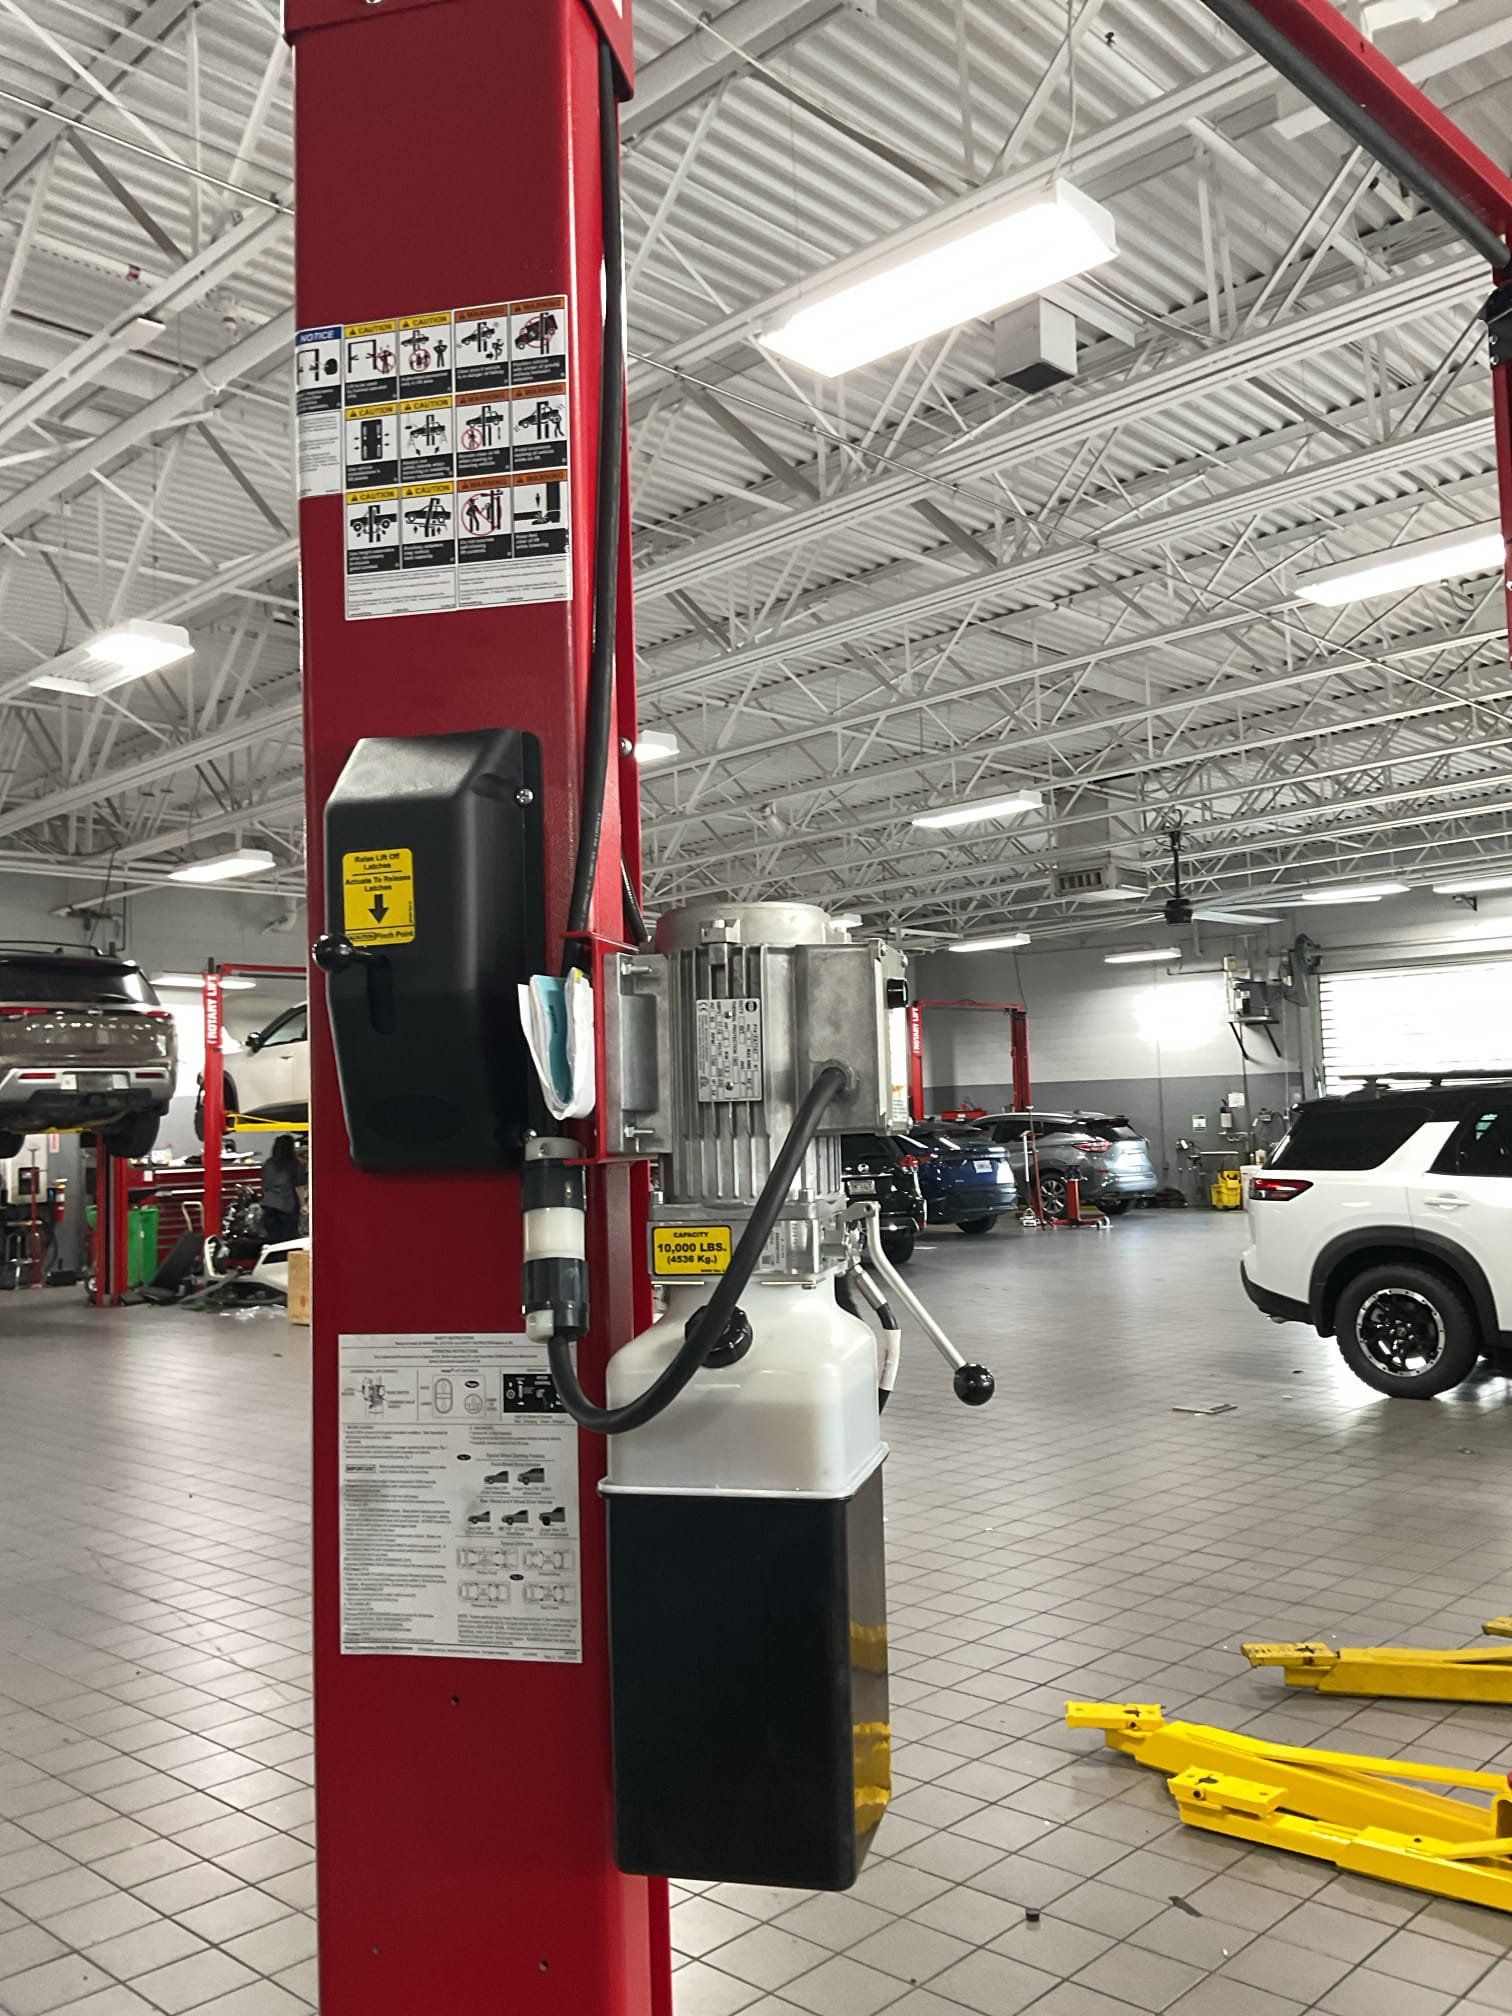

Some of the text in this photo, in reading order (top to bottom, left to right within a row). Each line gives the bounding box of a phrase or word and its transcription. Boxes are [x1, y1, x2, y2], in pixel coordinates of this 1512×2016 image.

[412, 316, 448, 326] CAUTION
[358, 324, 394, 334] CAUTION
[300, 330, 335, 342] NOTICE
[413, 399, 448, 410] CAUTION
[358, 406, 394, 417] CAUTION
[415, 485, 450, 494] CAUTION
[359, 490, 395, 500] CAUTION
[207, 975, 218, 1039] ROTARY LIFT
[657, 1242, 726, 1254] 10,000 LBS.
[667, 1255, 718, 1265] (4536 Kg.)
